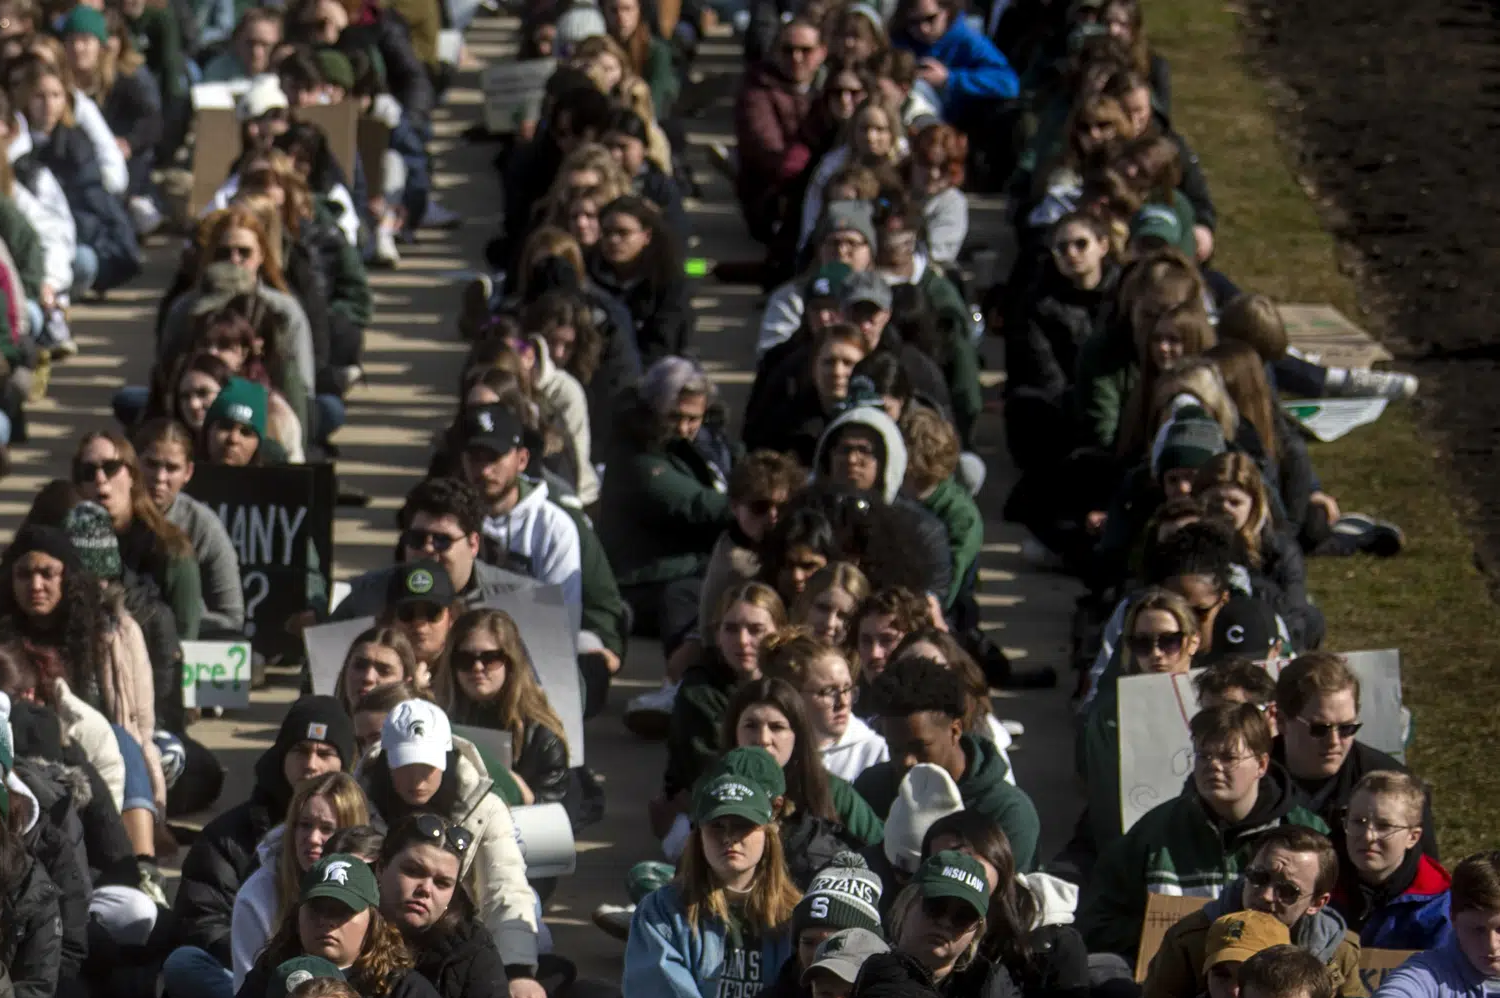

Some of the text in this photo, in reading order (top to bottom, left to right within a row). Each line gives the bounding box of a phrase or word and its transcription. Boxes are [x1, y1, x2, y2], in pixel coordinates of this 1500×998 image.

[1226, 625, 1245, 643] C
[942, 865, 984, 893] MSU LAW
[810, 897, 829, 918] S
